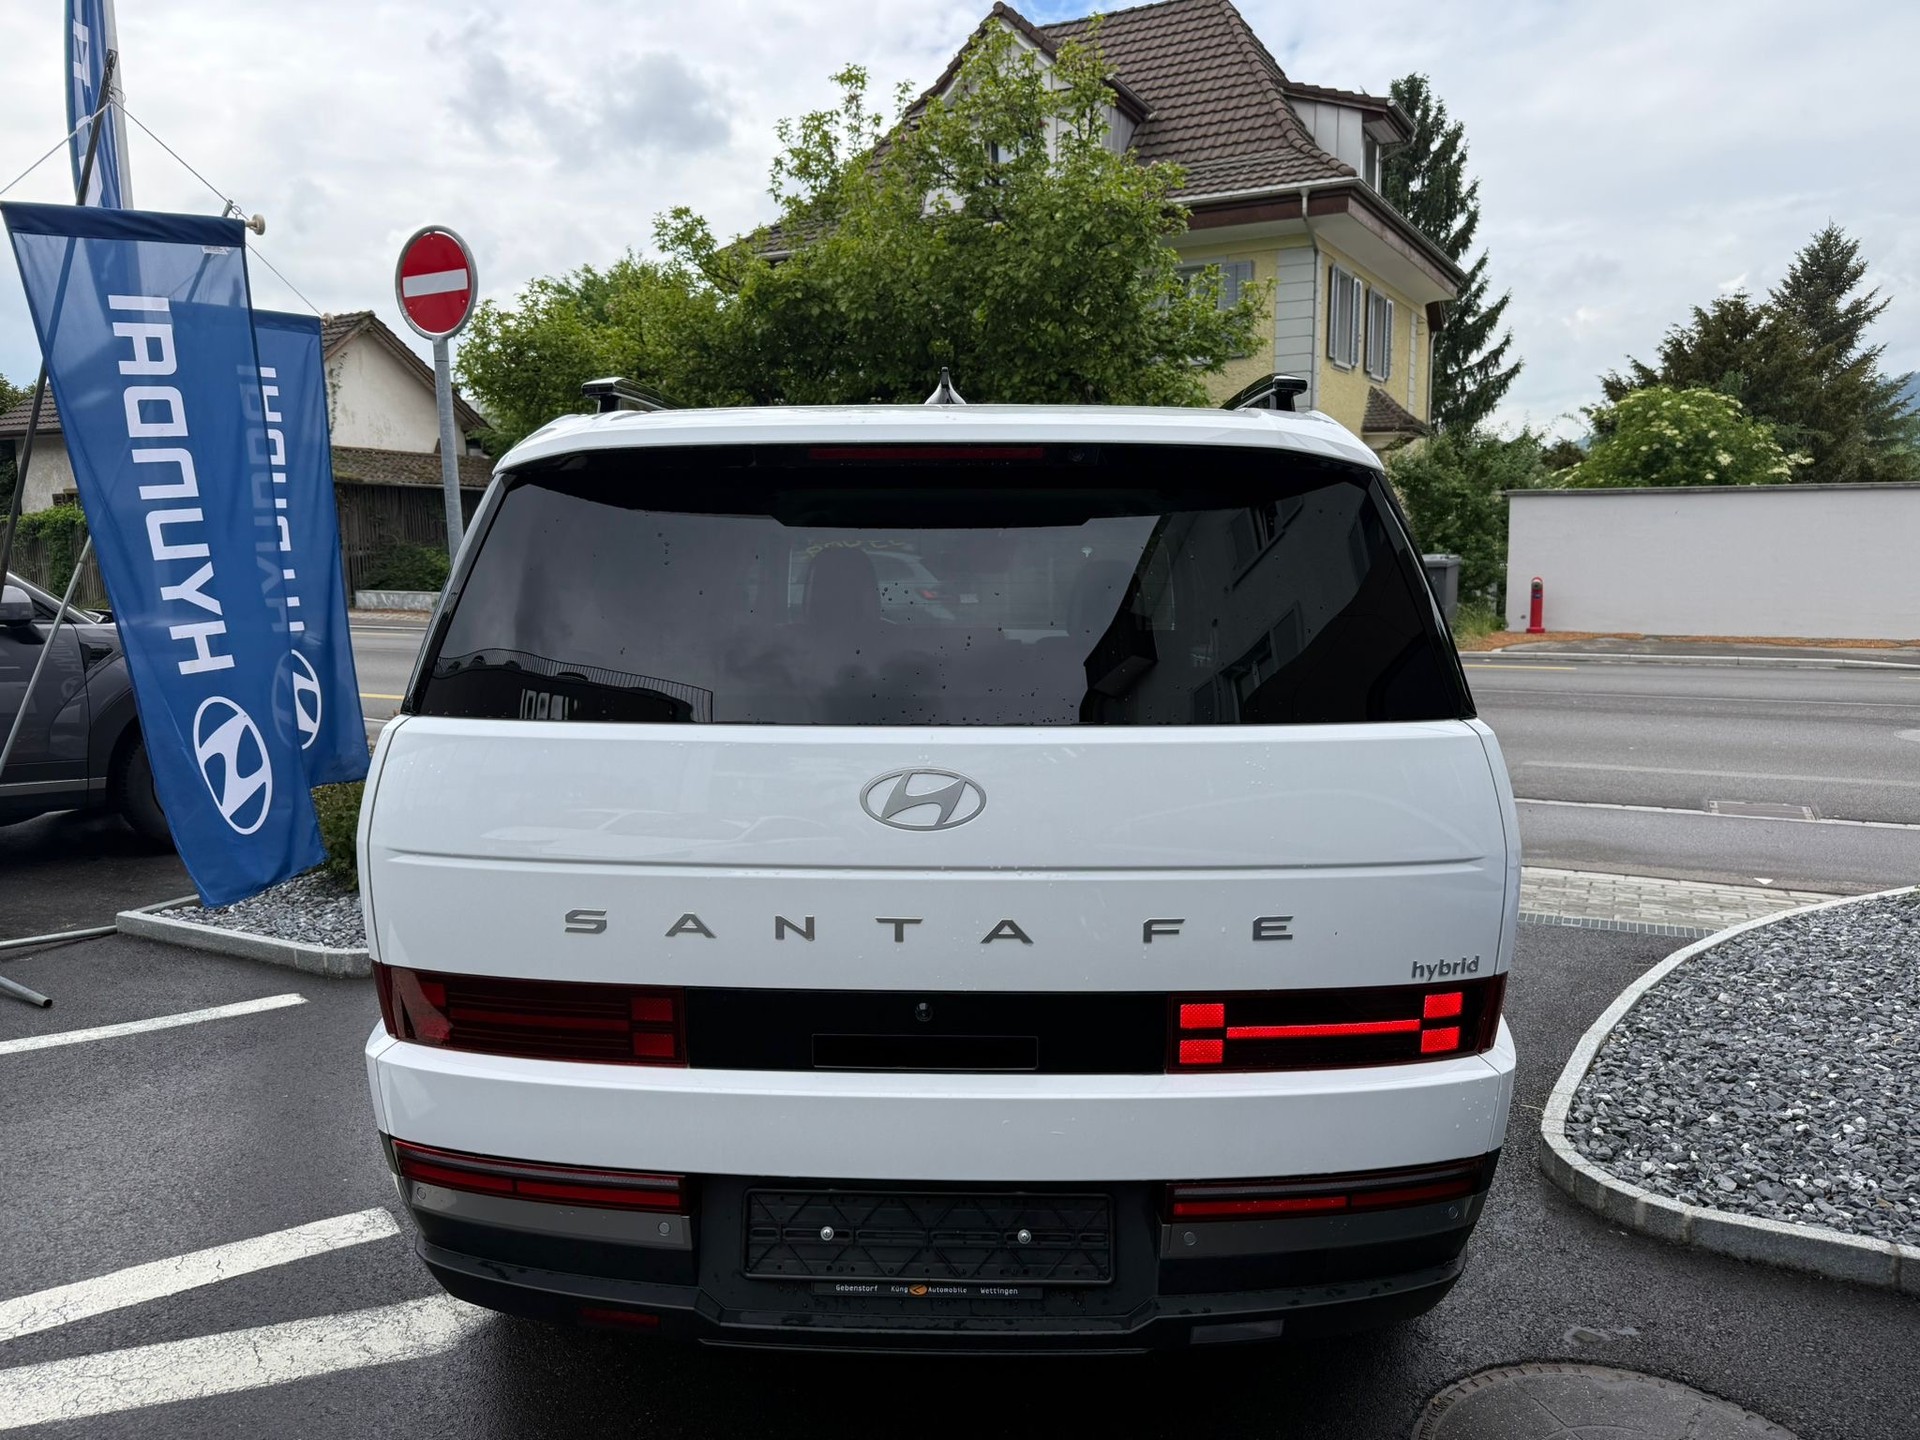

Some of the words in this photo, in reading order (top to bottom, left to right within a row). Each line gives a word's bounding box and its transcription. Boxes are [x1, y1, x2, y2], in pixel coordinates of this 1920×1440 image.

[564, 908, 1034, 945] SANTA
[1143, 915, 1294, 944] FE
[1411, 955, 1480, 981] hybrid
[835, 1284, 878, 1292] Gebenstorf
[890, 1285, 908, 1294] Küng
[928, 1286, 967, 1294] Automobile
[980, 1287, 1018, 1296] Wettingen
